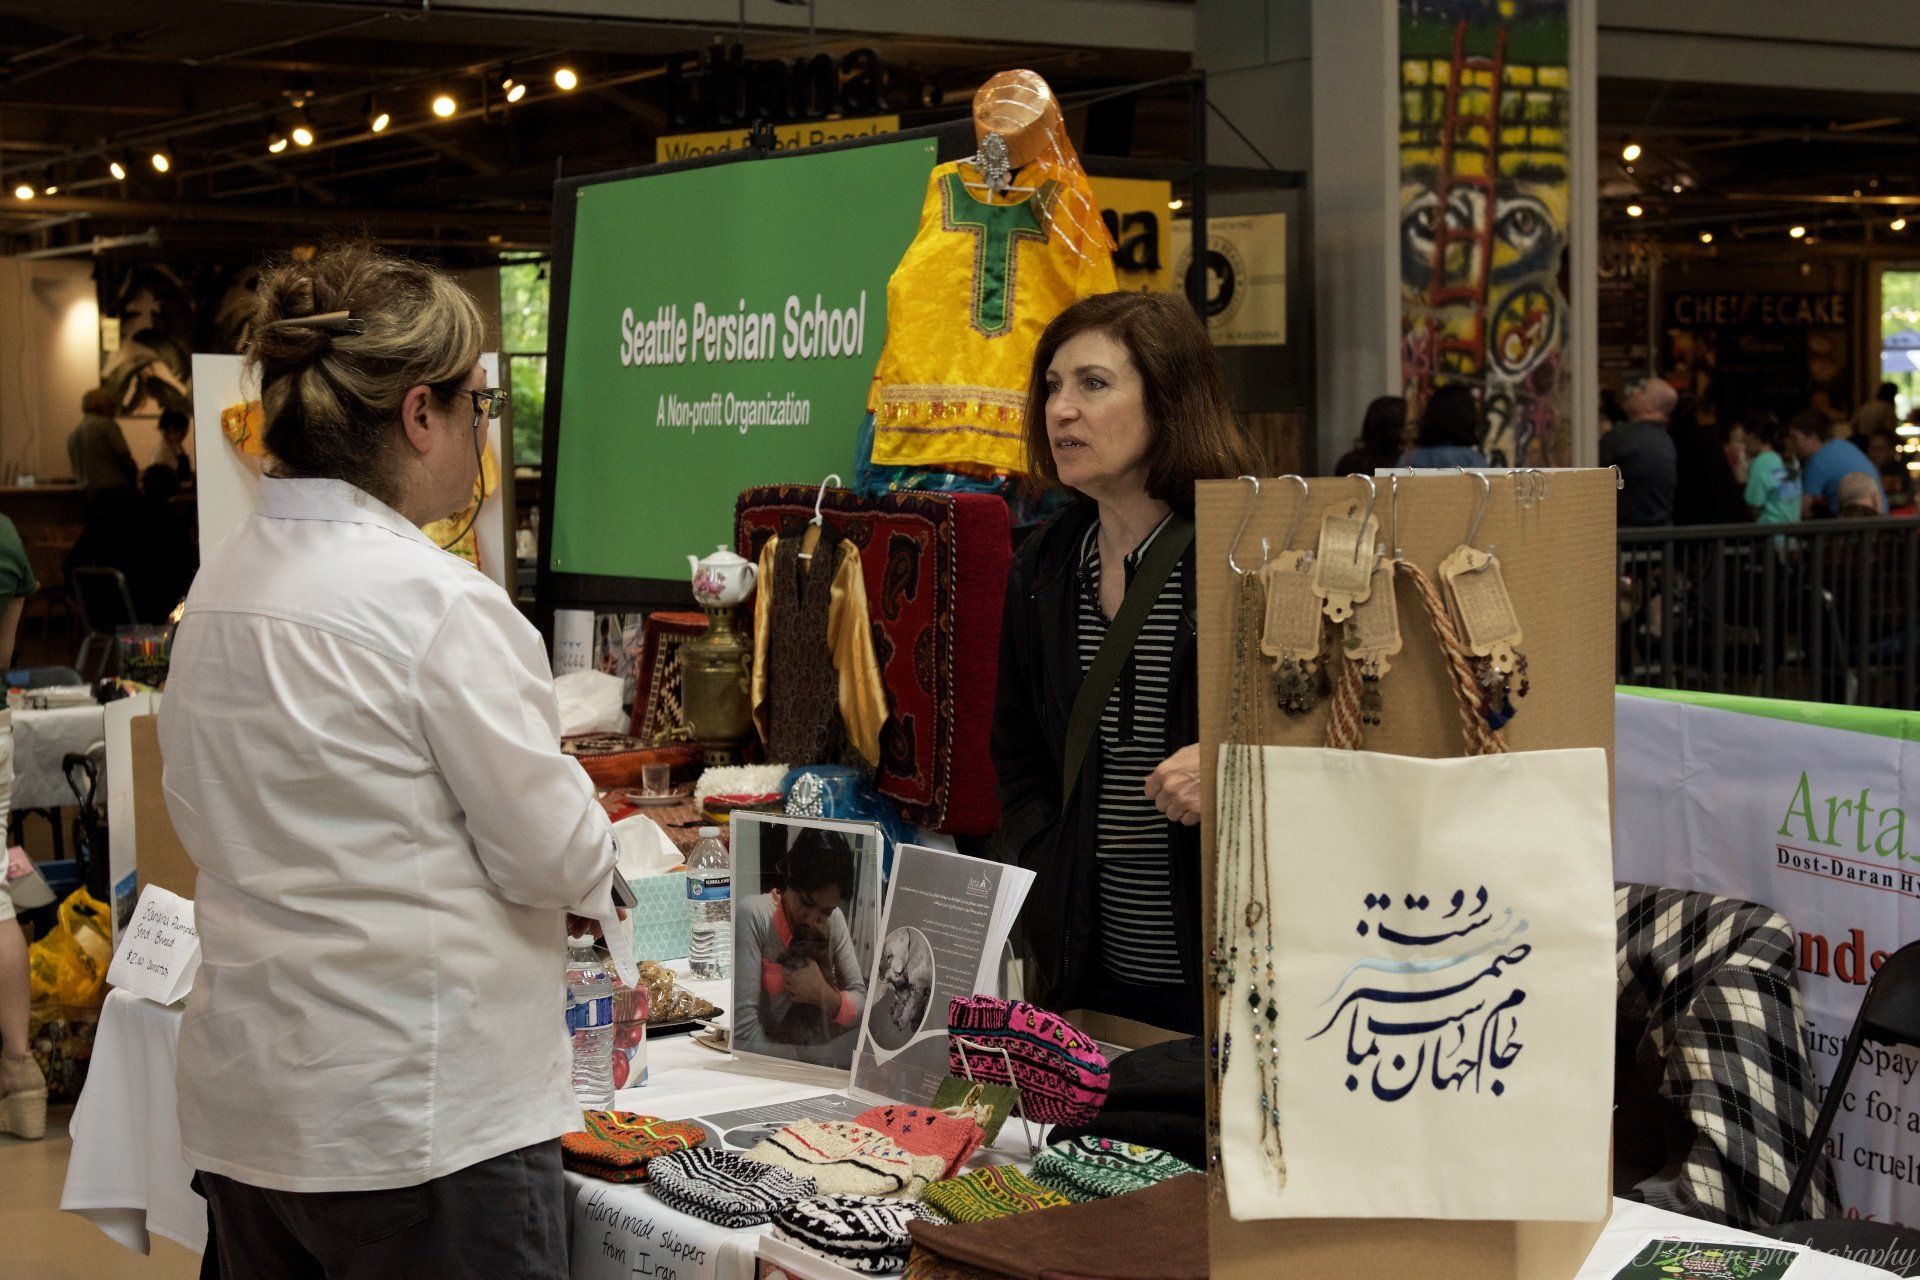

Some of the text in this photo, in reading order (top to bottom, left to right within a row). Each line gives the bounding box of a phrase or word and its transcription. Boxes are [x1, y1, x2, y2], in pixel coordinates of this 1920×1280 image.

[621, 290, 866, 366] Seattle Persian School
[1674, 294, 1847, 325] CHEECAKE
[656, 392, 810, 434] A Non-profit Organization
[1777, 770, 1909, 860] Arta
[1777, 847, 1893, 888] Dost-Daran
[154, 930, 176, 948] Bread
[621, 1212, 655, 1241] made
[602, 1231, 678, 1280] from Iran
